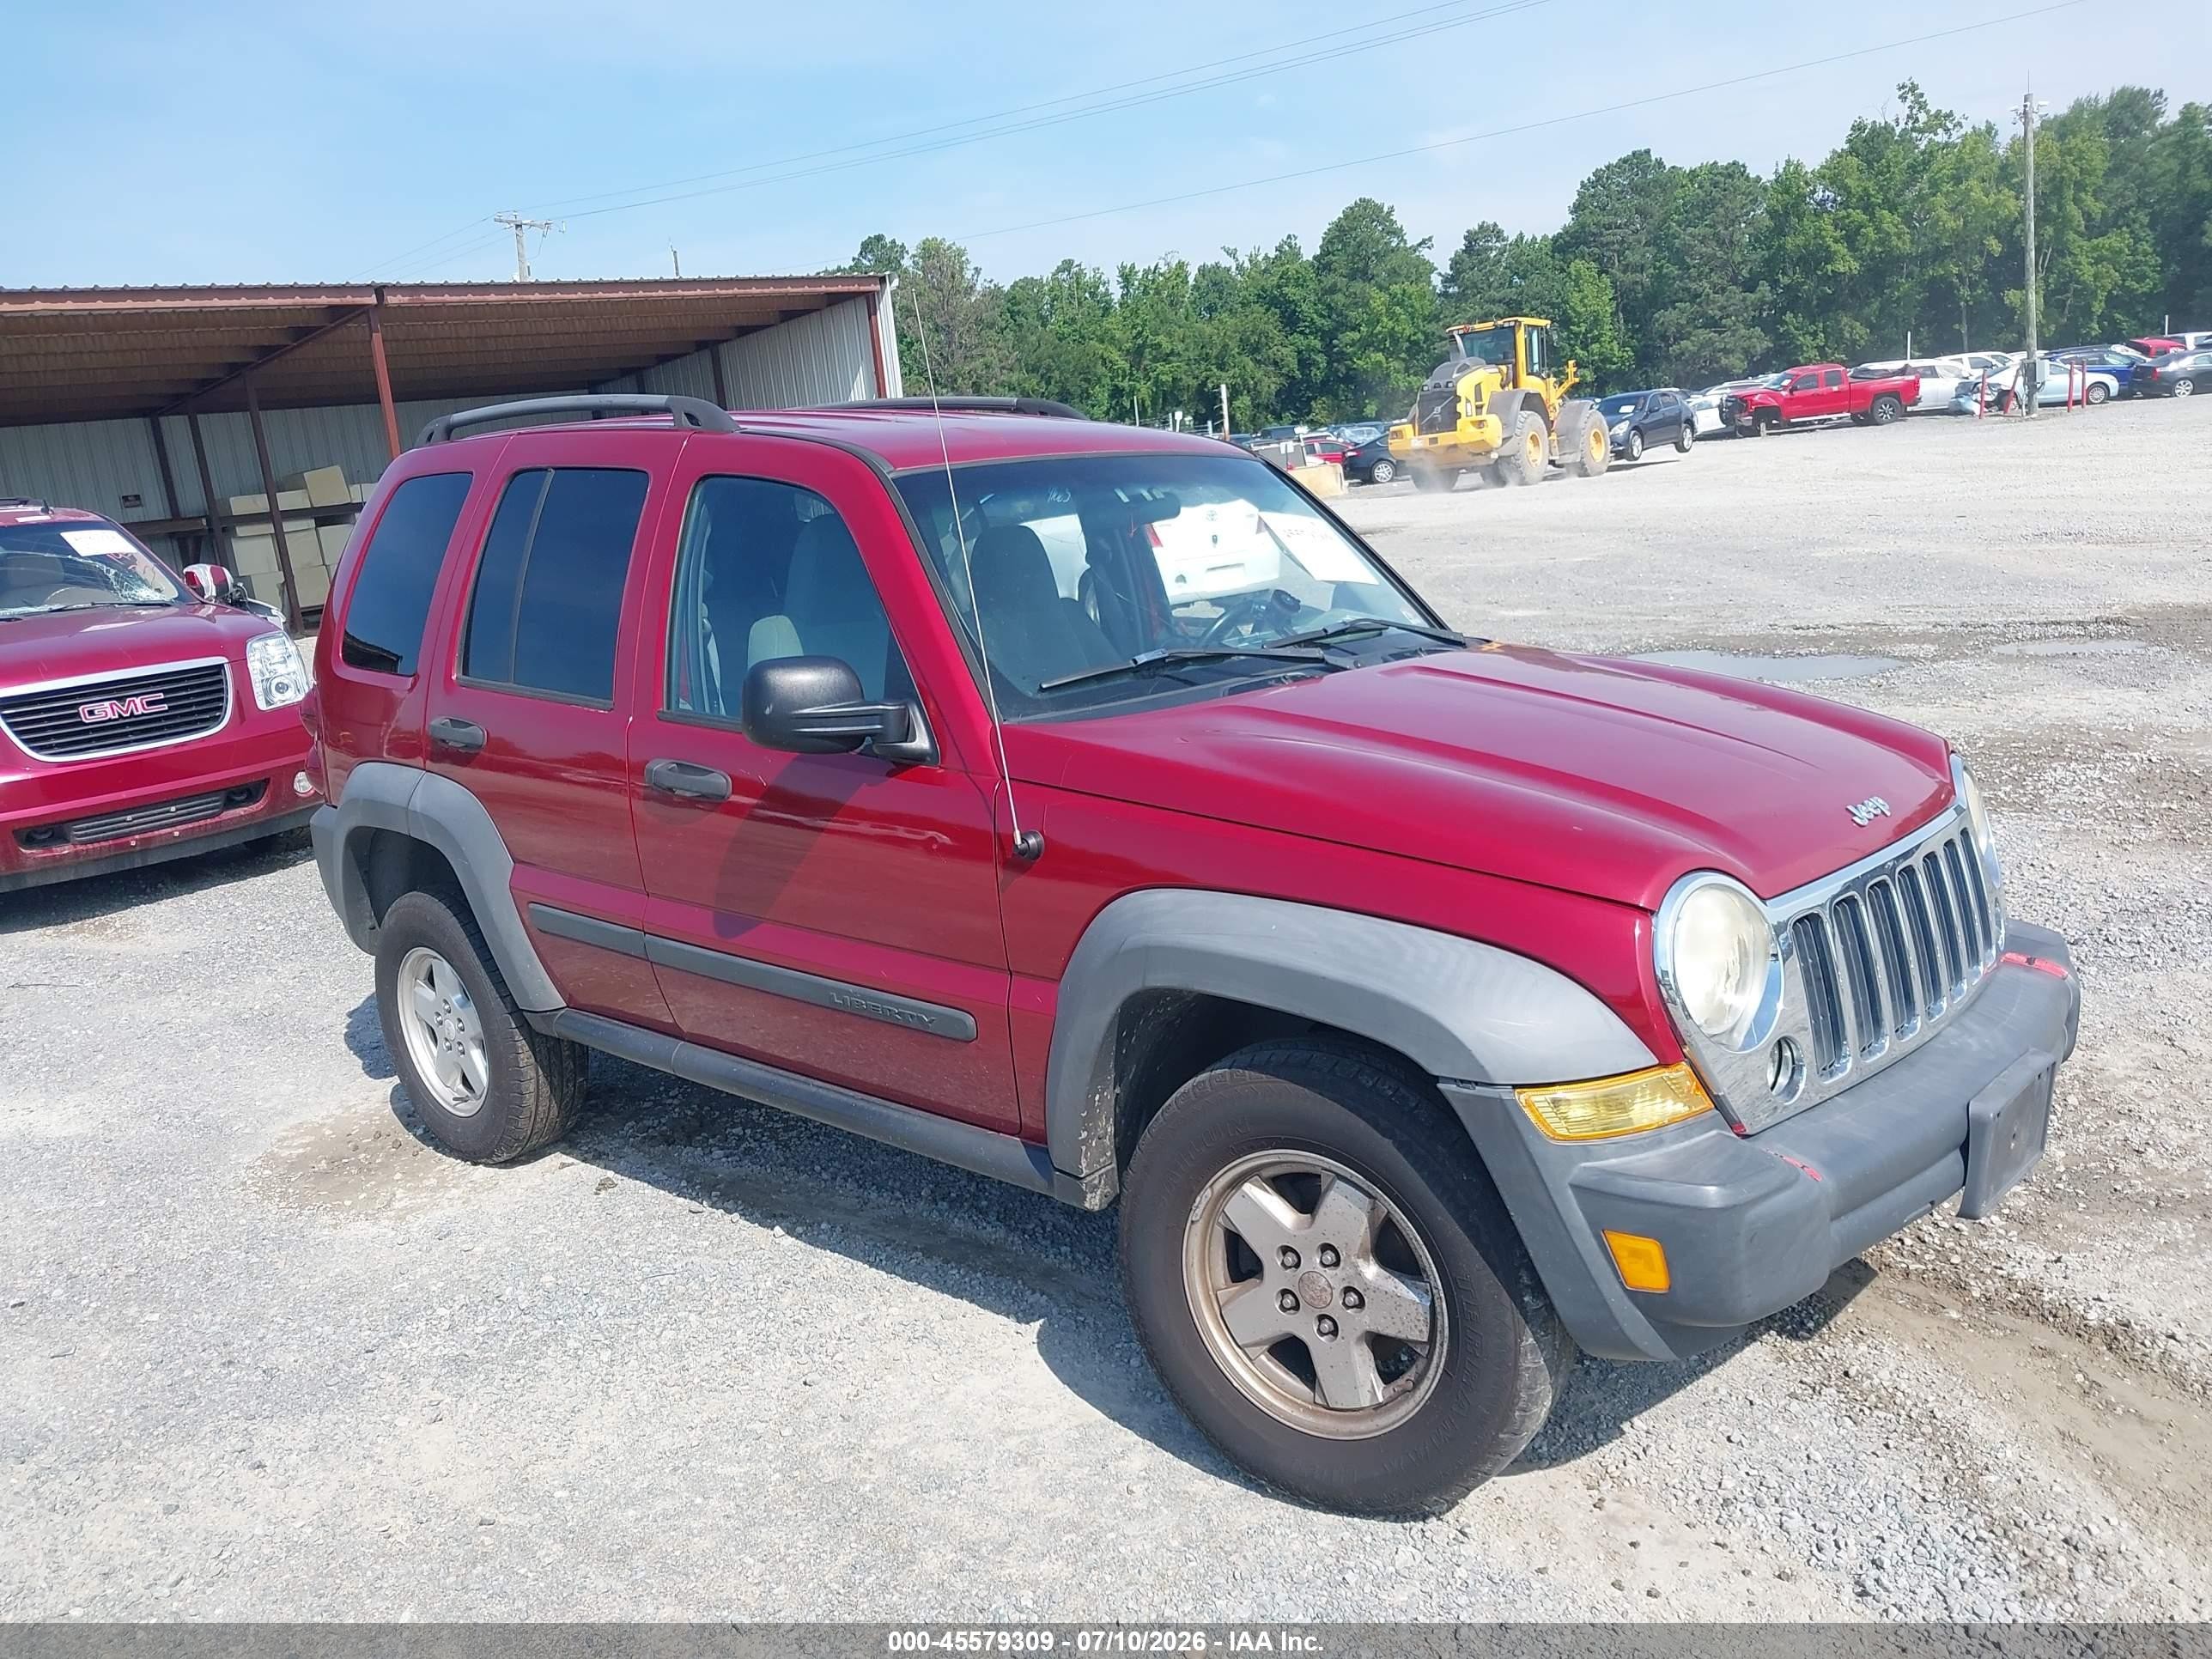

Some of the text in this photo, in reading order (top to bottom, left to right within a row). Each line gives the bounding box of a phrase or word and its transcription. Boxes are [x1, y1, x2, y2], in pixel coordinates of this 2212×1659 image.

[79, 693, 168, 723] GMC
[1846, 795, 1892, 827] Jeep
[831, 992, 936, 1027] LIBERTY
